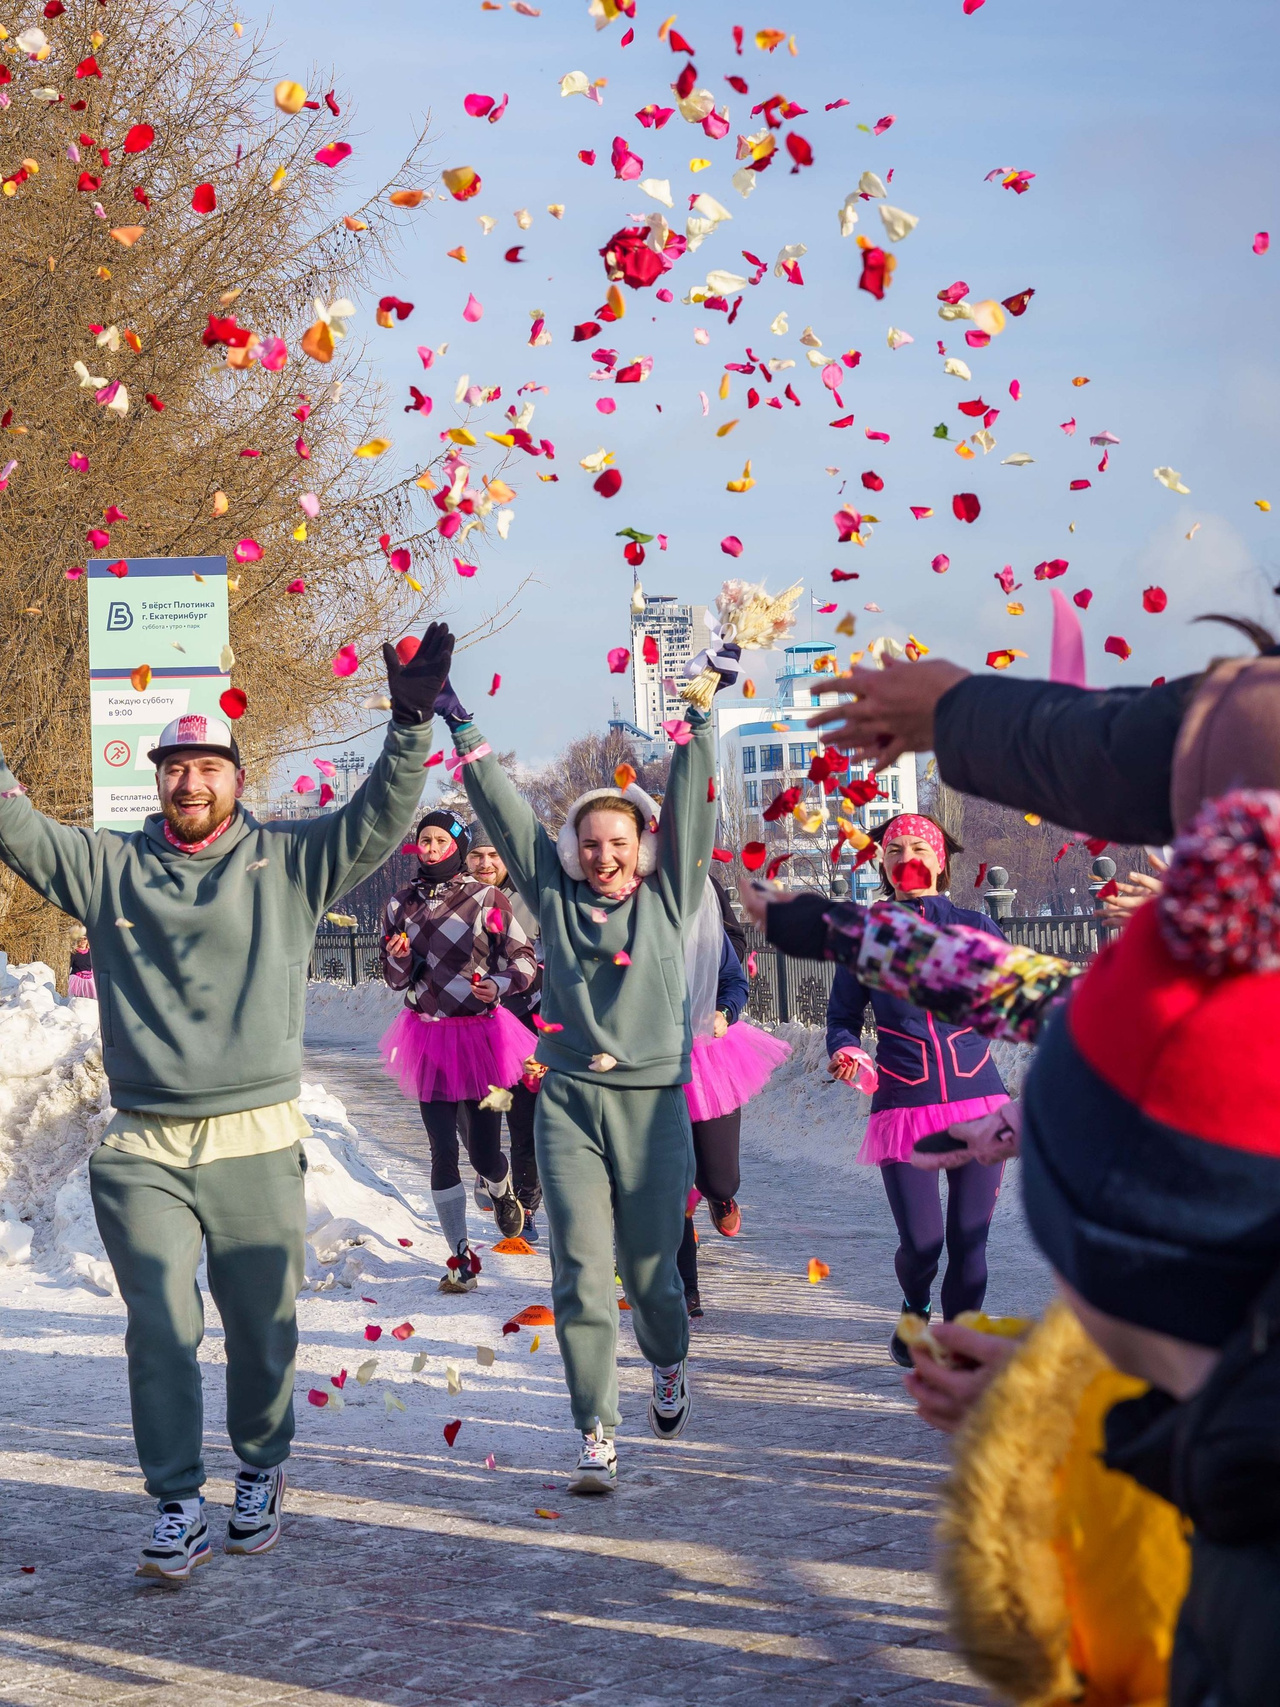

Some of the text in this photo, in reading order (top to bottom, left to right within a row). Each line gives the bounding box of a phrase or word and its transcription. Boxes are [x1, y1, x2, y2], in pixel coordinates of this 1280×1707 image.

[148, 601, 172, 611] вёрст
[173, 600, 215, 609] Плотинка
[149, 611, 208, 621] Екатеринбург
[108, 697, 174, 706] Каждую субботу
[179, 715, 207, 725] MARVEL
[178, 722, 207, 733] MARVEL
[177, 732, 206, 742] MARVEL
[110, 793, 152, 801] Бесплатно
